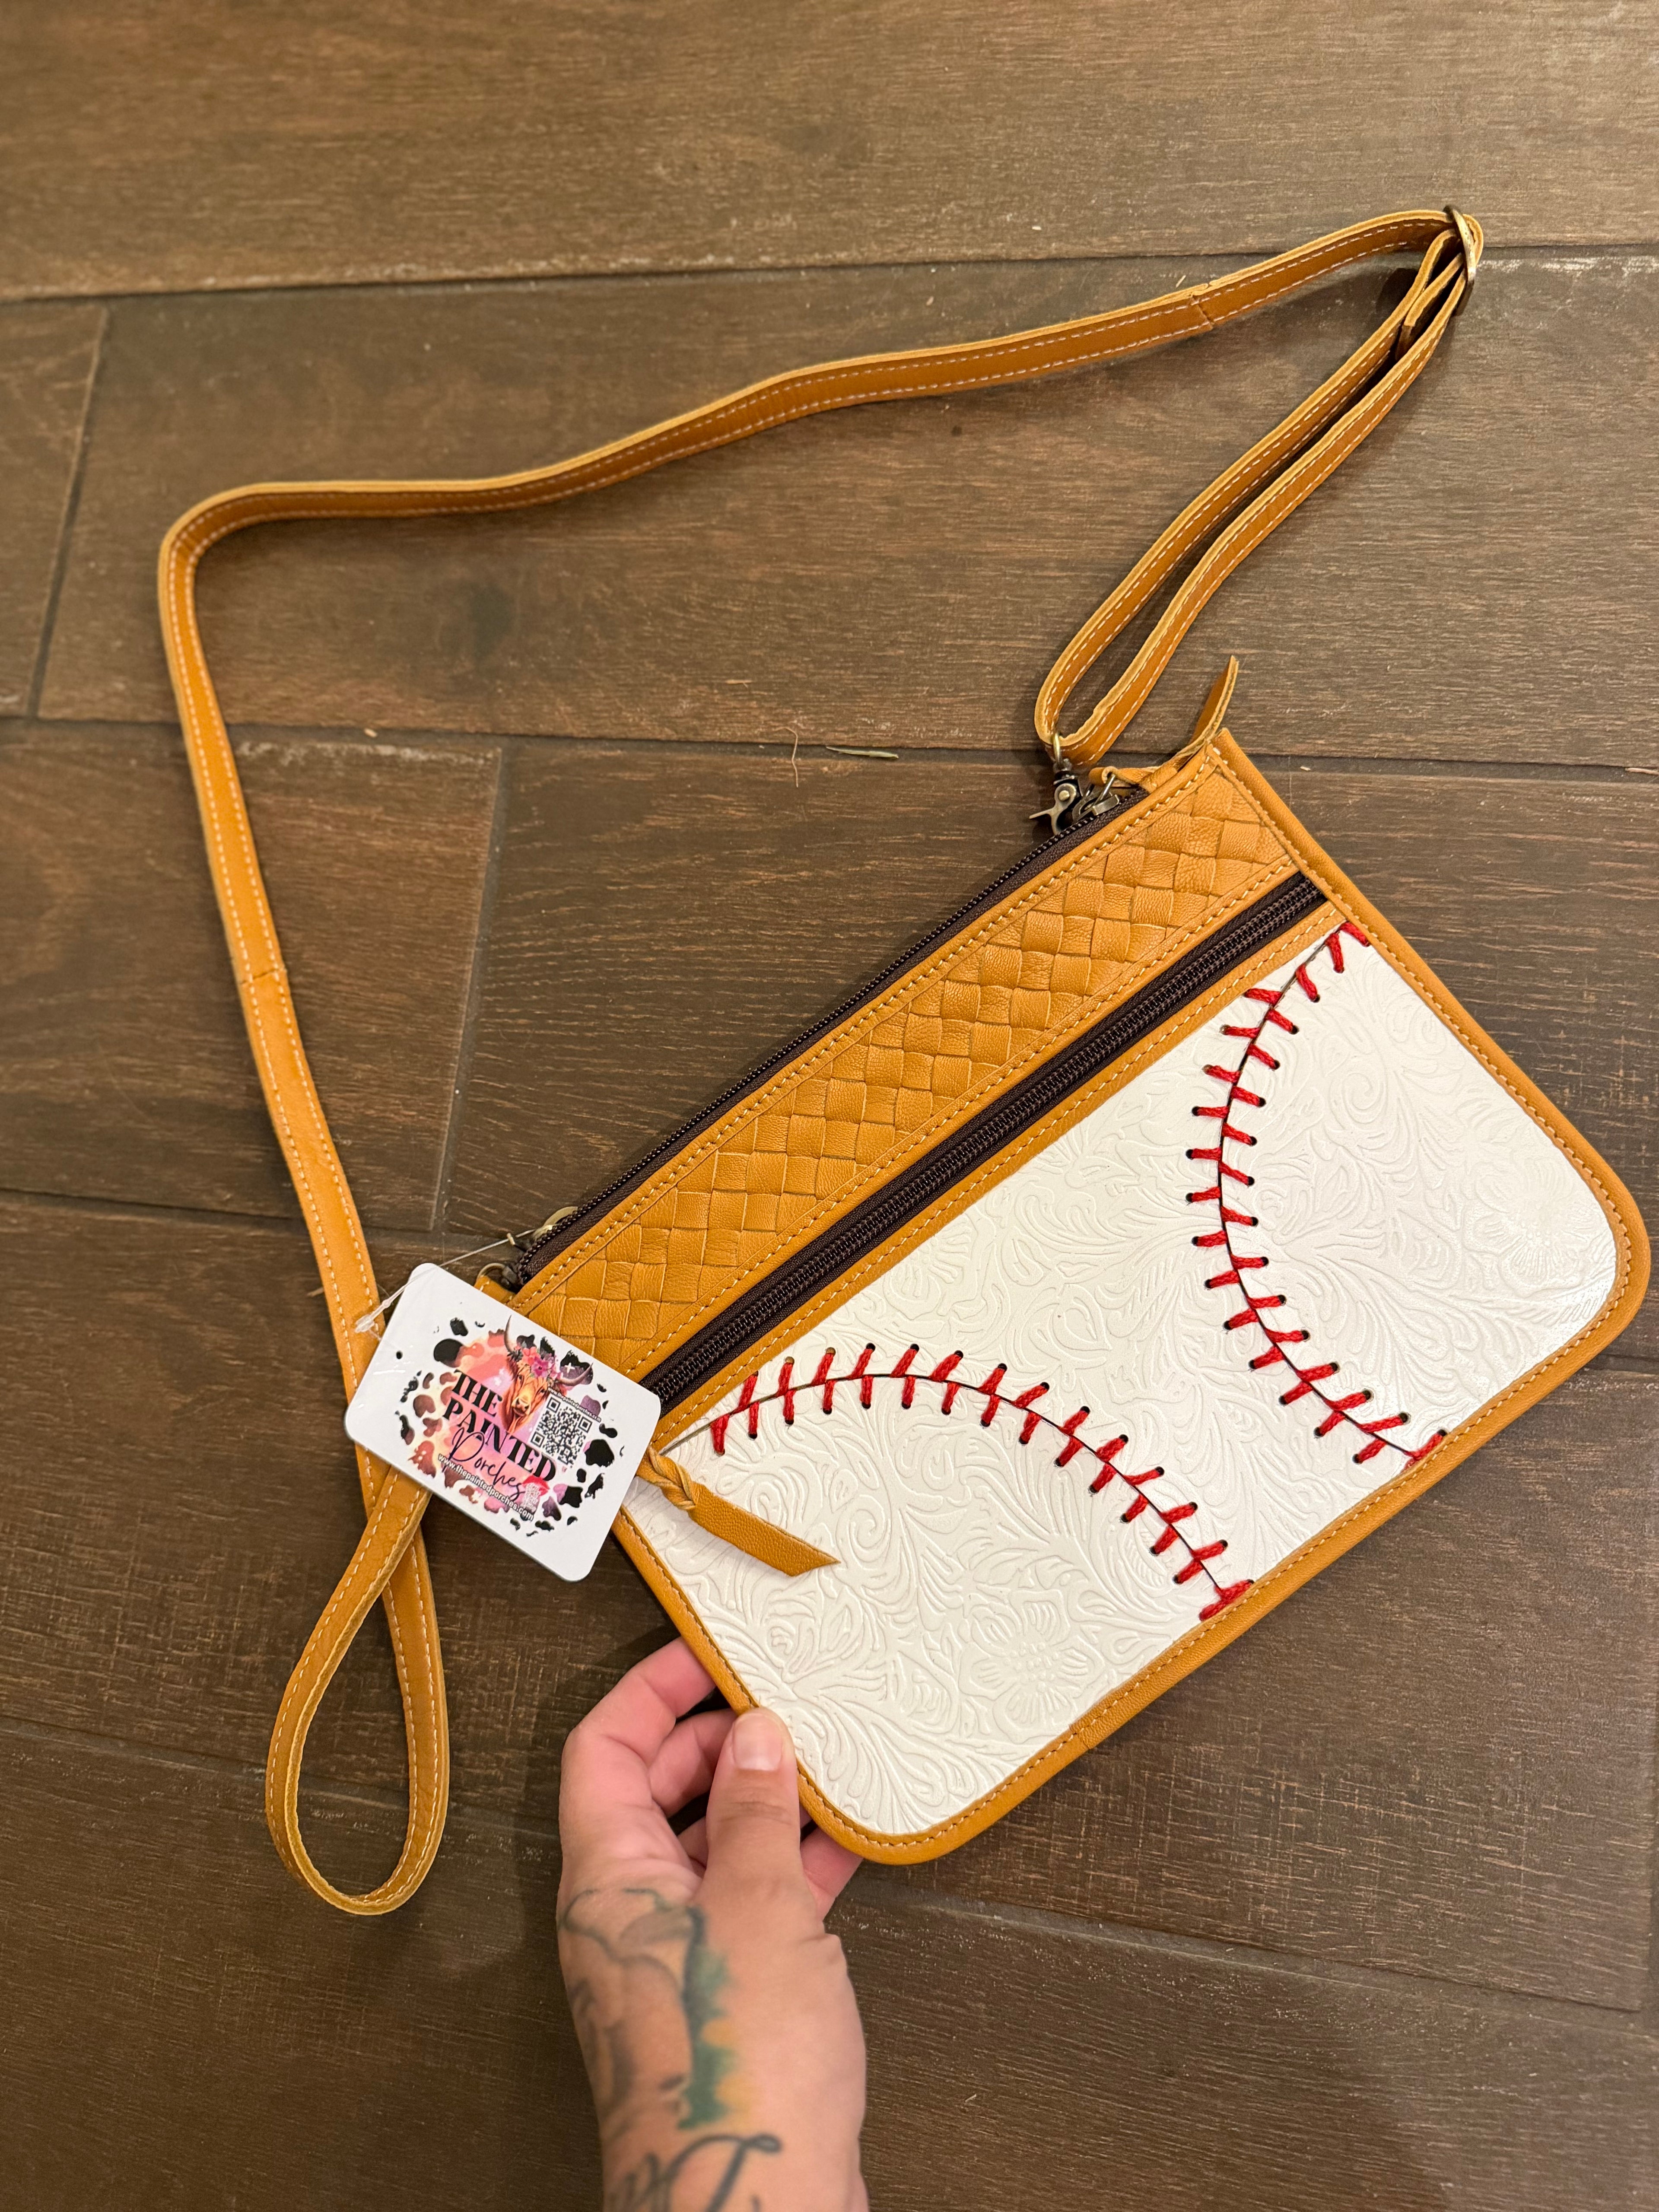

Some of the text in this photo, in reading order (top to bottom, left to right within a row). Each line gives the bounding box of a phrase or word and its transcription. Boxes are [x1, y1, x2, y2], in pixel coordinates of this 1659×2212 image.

[451, 1370, 502, 1417] THE
[442, 1427, 526, 1501] Porches
[443, 1397, 556, 1481] PAINTED
[438, 1453, 534, 1521] www.thepaintedporches.com
